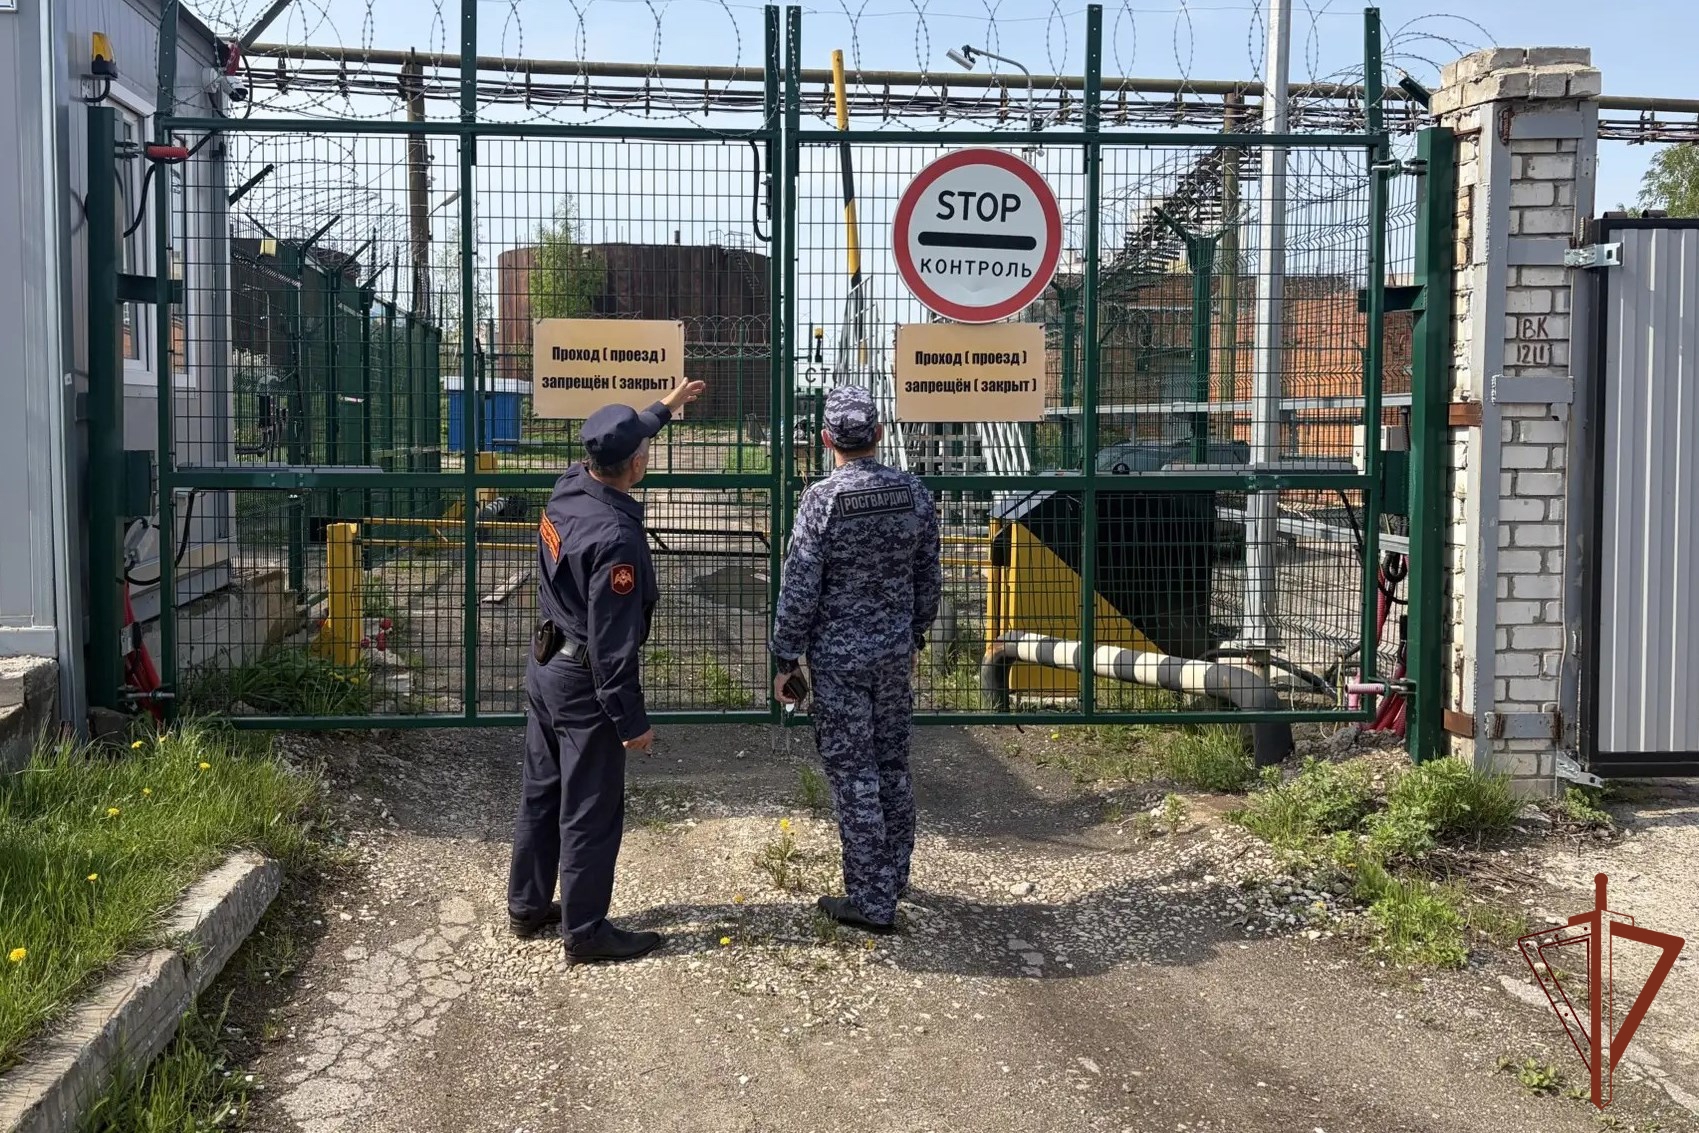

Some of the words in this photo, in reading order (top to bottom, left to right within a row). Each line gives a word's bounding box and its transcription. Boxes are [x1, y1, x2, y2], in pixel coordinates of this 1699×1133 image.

[936, 190, 1022, 223] STOP
[920, 258, 1032, 278] КОНТРОЛЬ
[552, 346, 600, 363] Проход
[915, 351, 962, 366] Проход
[542, 375, 609, 391] запрещён
[905, 378, 971, 394] запрещён
[844, 490, 909, 511] РОСГВАРДИЯ
